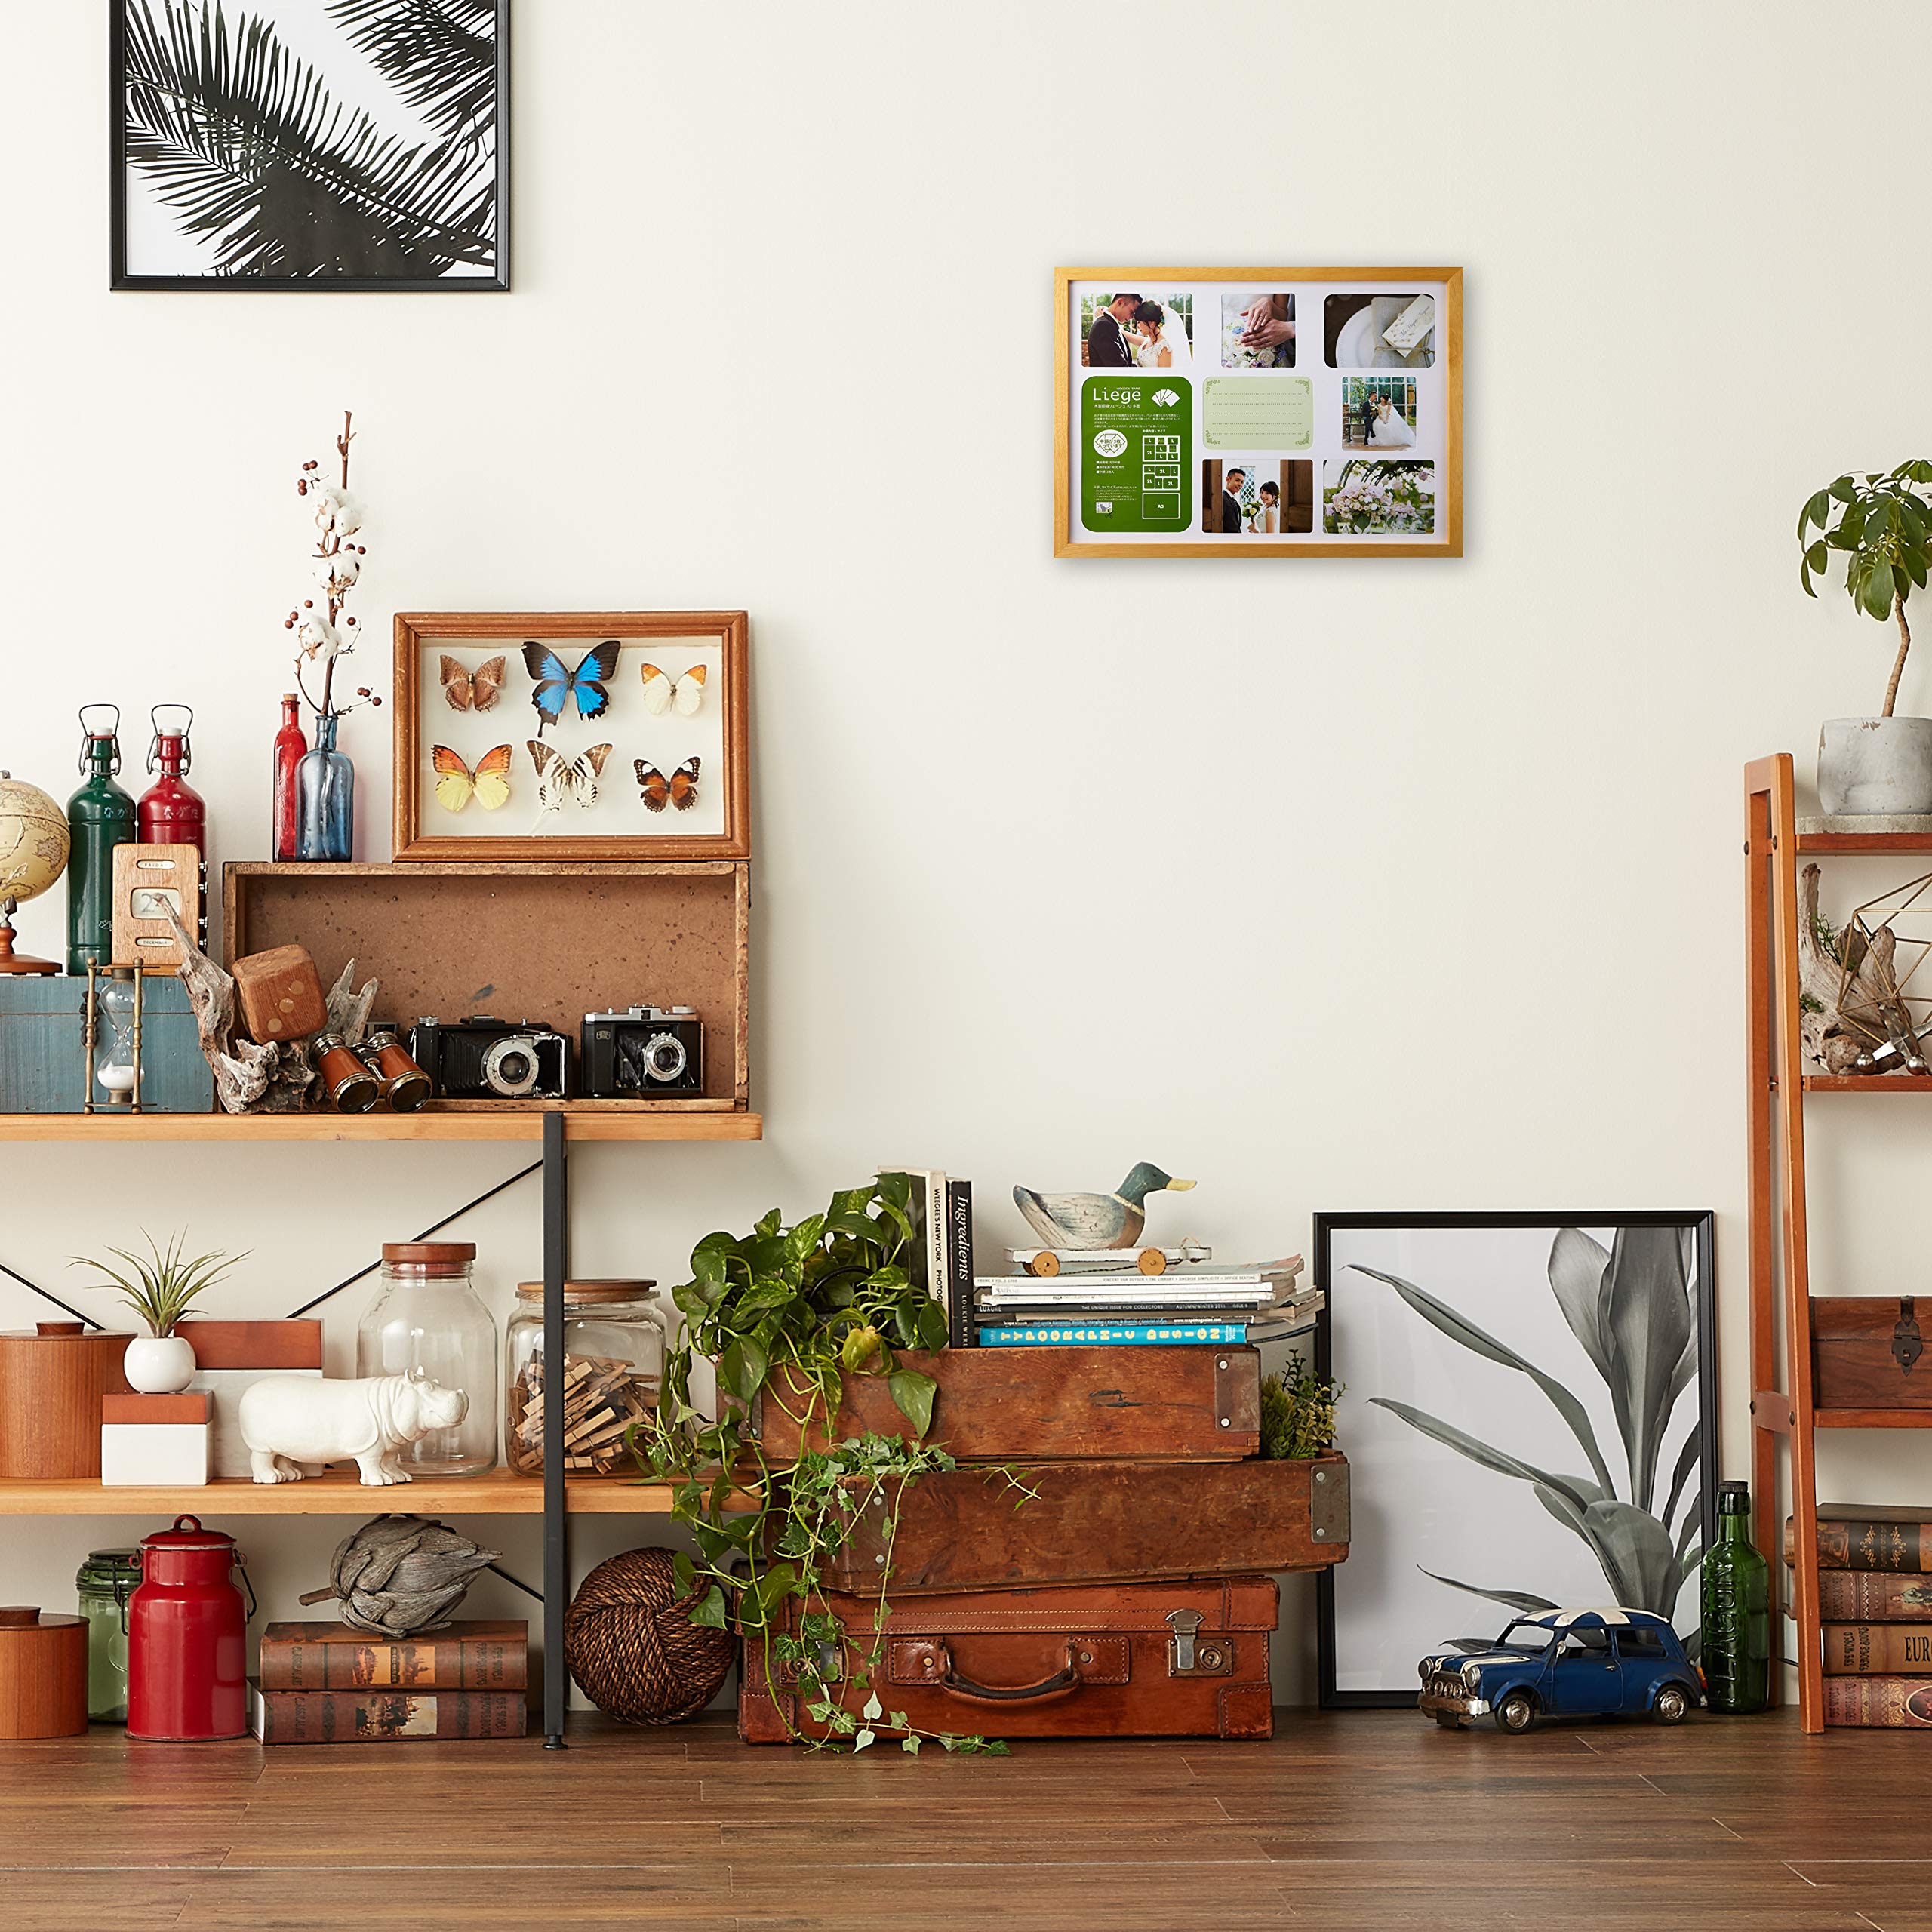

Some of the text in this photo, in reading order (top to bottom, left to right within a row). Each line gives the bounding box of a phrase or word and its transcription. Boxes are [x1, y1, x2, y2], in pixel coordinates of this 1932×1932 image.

[1093, 387, 1141, 404] Liege
[955, 1195, 970, 1281] Ingredients
[1001, 1329, 1135, 1343] TYPOGRAPHIC
[1146, 1327, 1220, 1340] DESIGN
[1904, 1636, 1932, 1662] EUR
